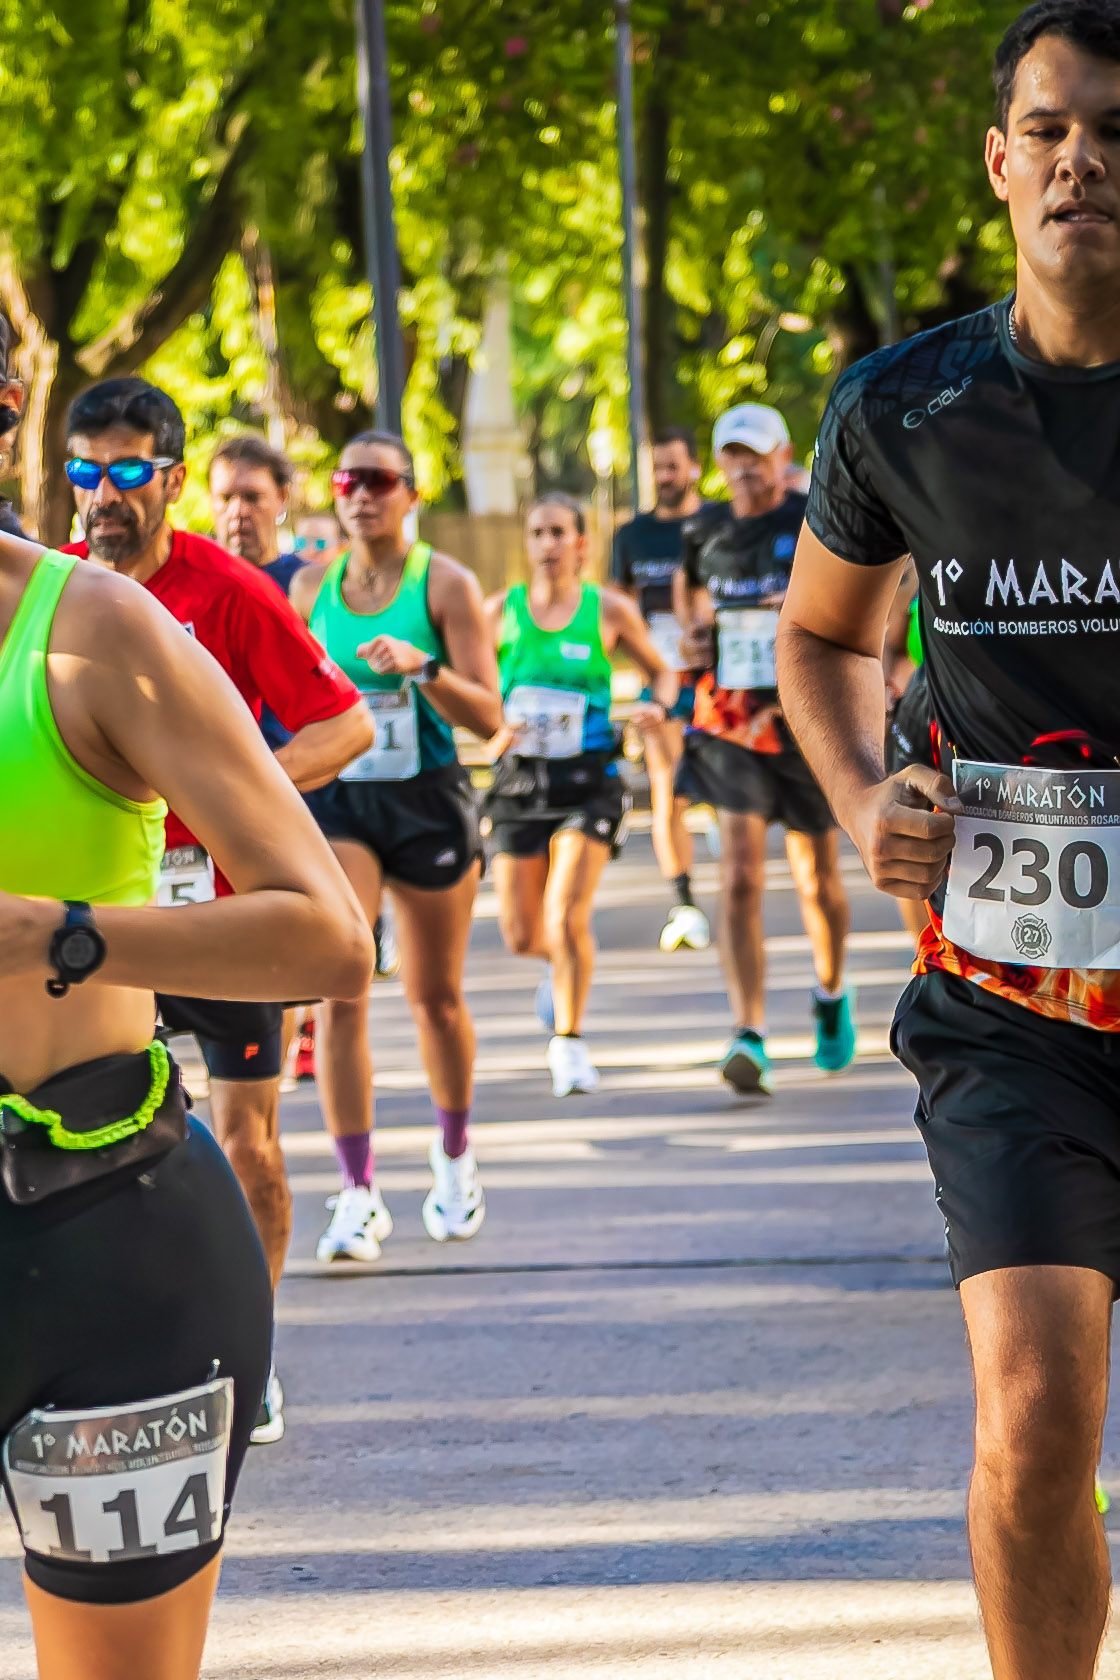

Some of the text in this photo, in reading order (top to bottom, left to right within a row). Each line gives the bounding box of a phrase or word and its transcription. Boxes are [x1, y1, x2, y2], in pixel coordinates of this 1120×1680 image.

[985, 558, 1120, 606] MARA
[998, 620, 1077, 635] BOMBEROS
[1081, 619, 1120, 633] VOLU
[997, 778, 1105, 809] MARATÓN
[1035, 813, 1088, 826] VOLUNTARIOS
[1090, 814, 1120, 826] ROSAR
[967, 832, 1109, 910] 230
[1023, 927, 1040, 943] 27
[66, 1407, 208, 1459] MARATÓN
[40, 1472, 217, 1562] 114
